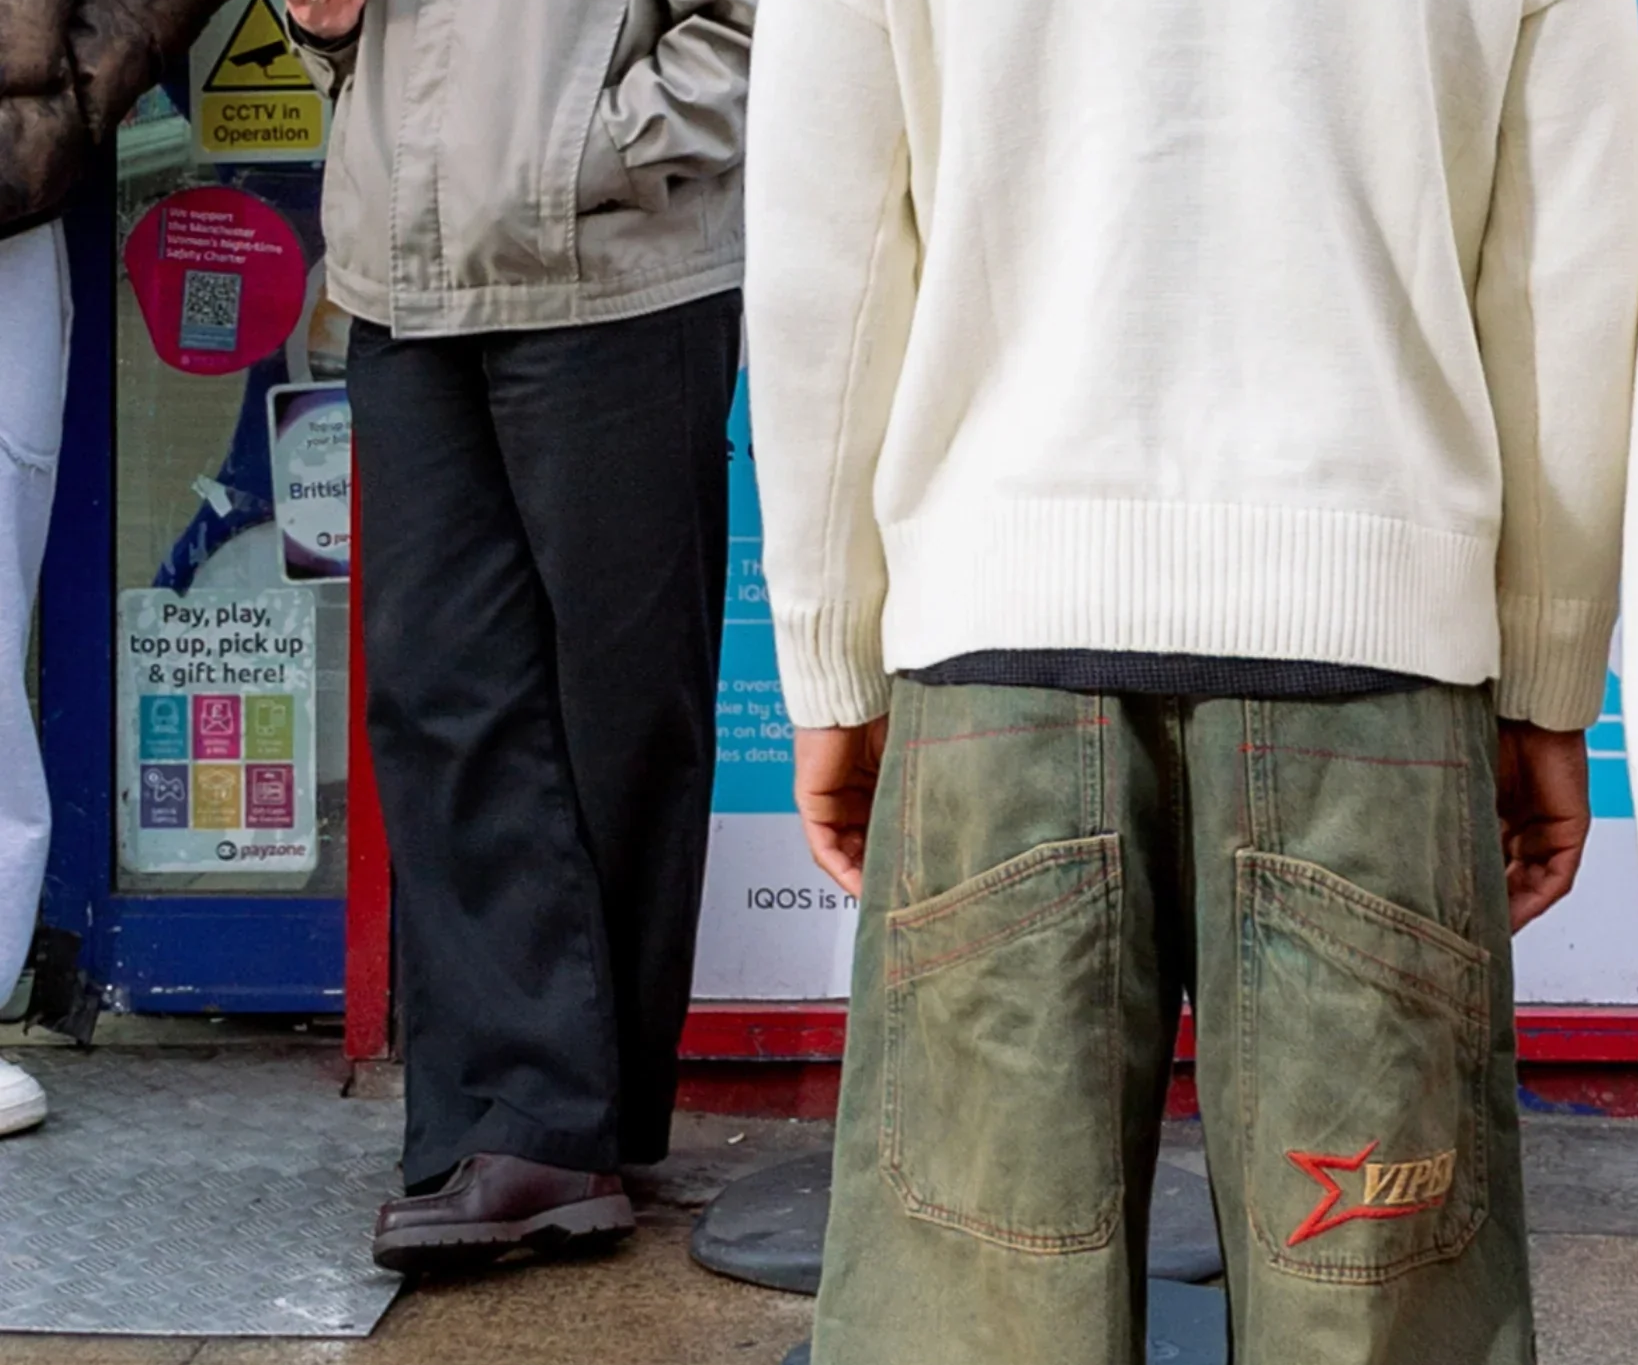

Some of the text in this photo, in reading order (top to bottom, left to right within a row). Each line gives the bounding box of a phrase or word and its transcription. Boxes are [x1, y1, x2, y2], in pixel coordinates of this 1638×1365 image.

[221, 103, 300, 121] CCTV in
[213, 124, 309, 146] Operation
[204, 251, 246, 264] Charter
[163, 602, 271, 628] Pay, play,
[130, 632, 303, 657] top up, pick up
[149, 662, 285, 688] & gift here!
[748, 701, 770, 719] by
[745, 748, 792, 762] data.
[240, 844, 306, 860] payzone
[747, 887, 812, 909] IQOS
[819, 888, 837, 909] is
